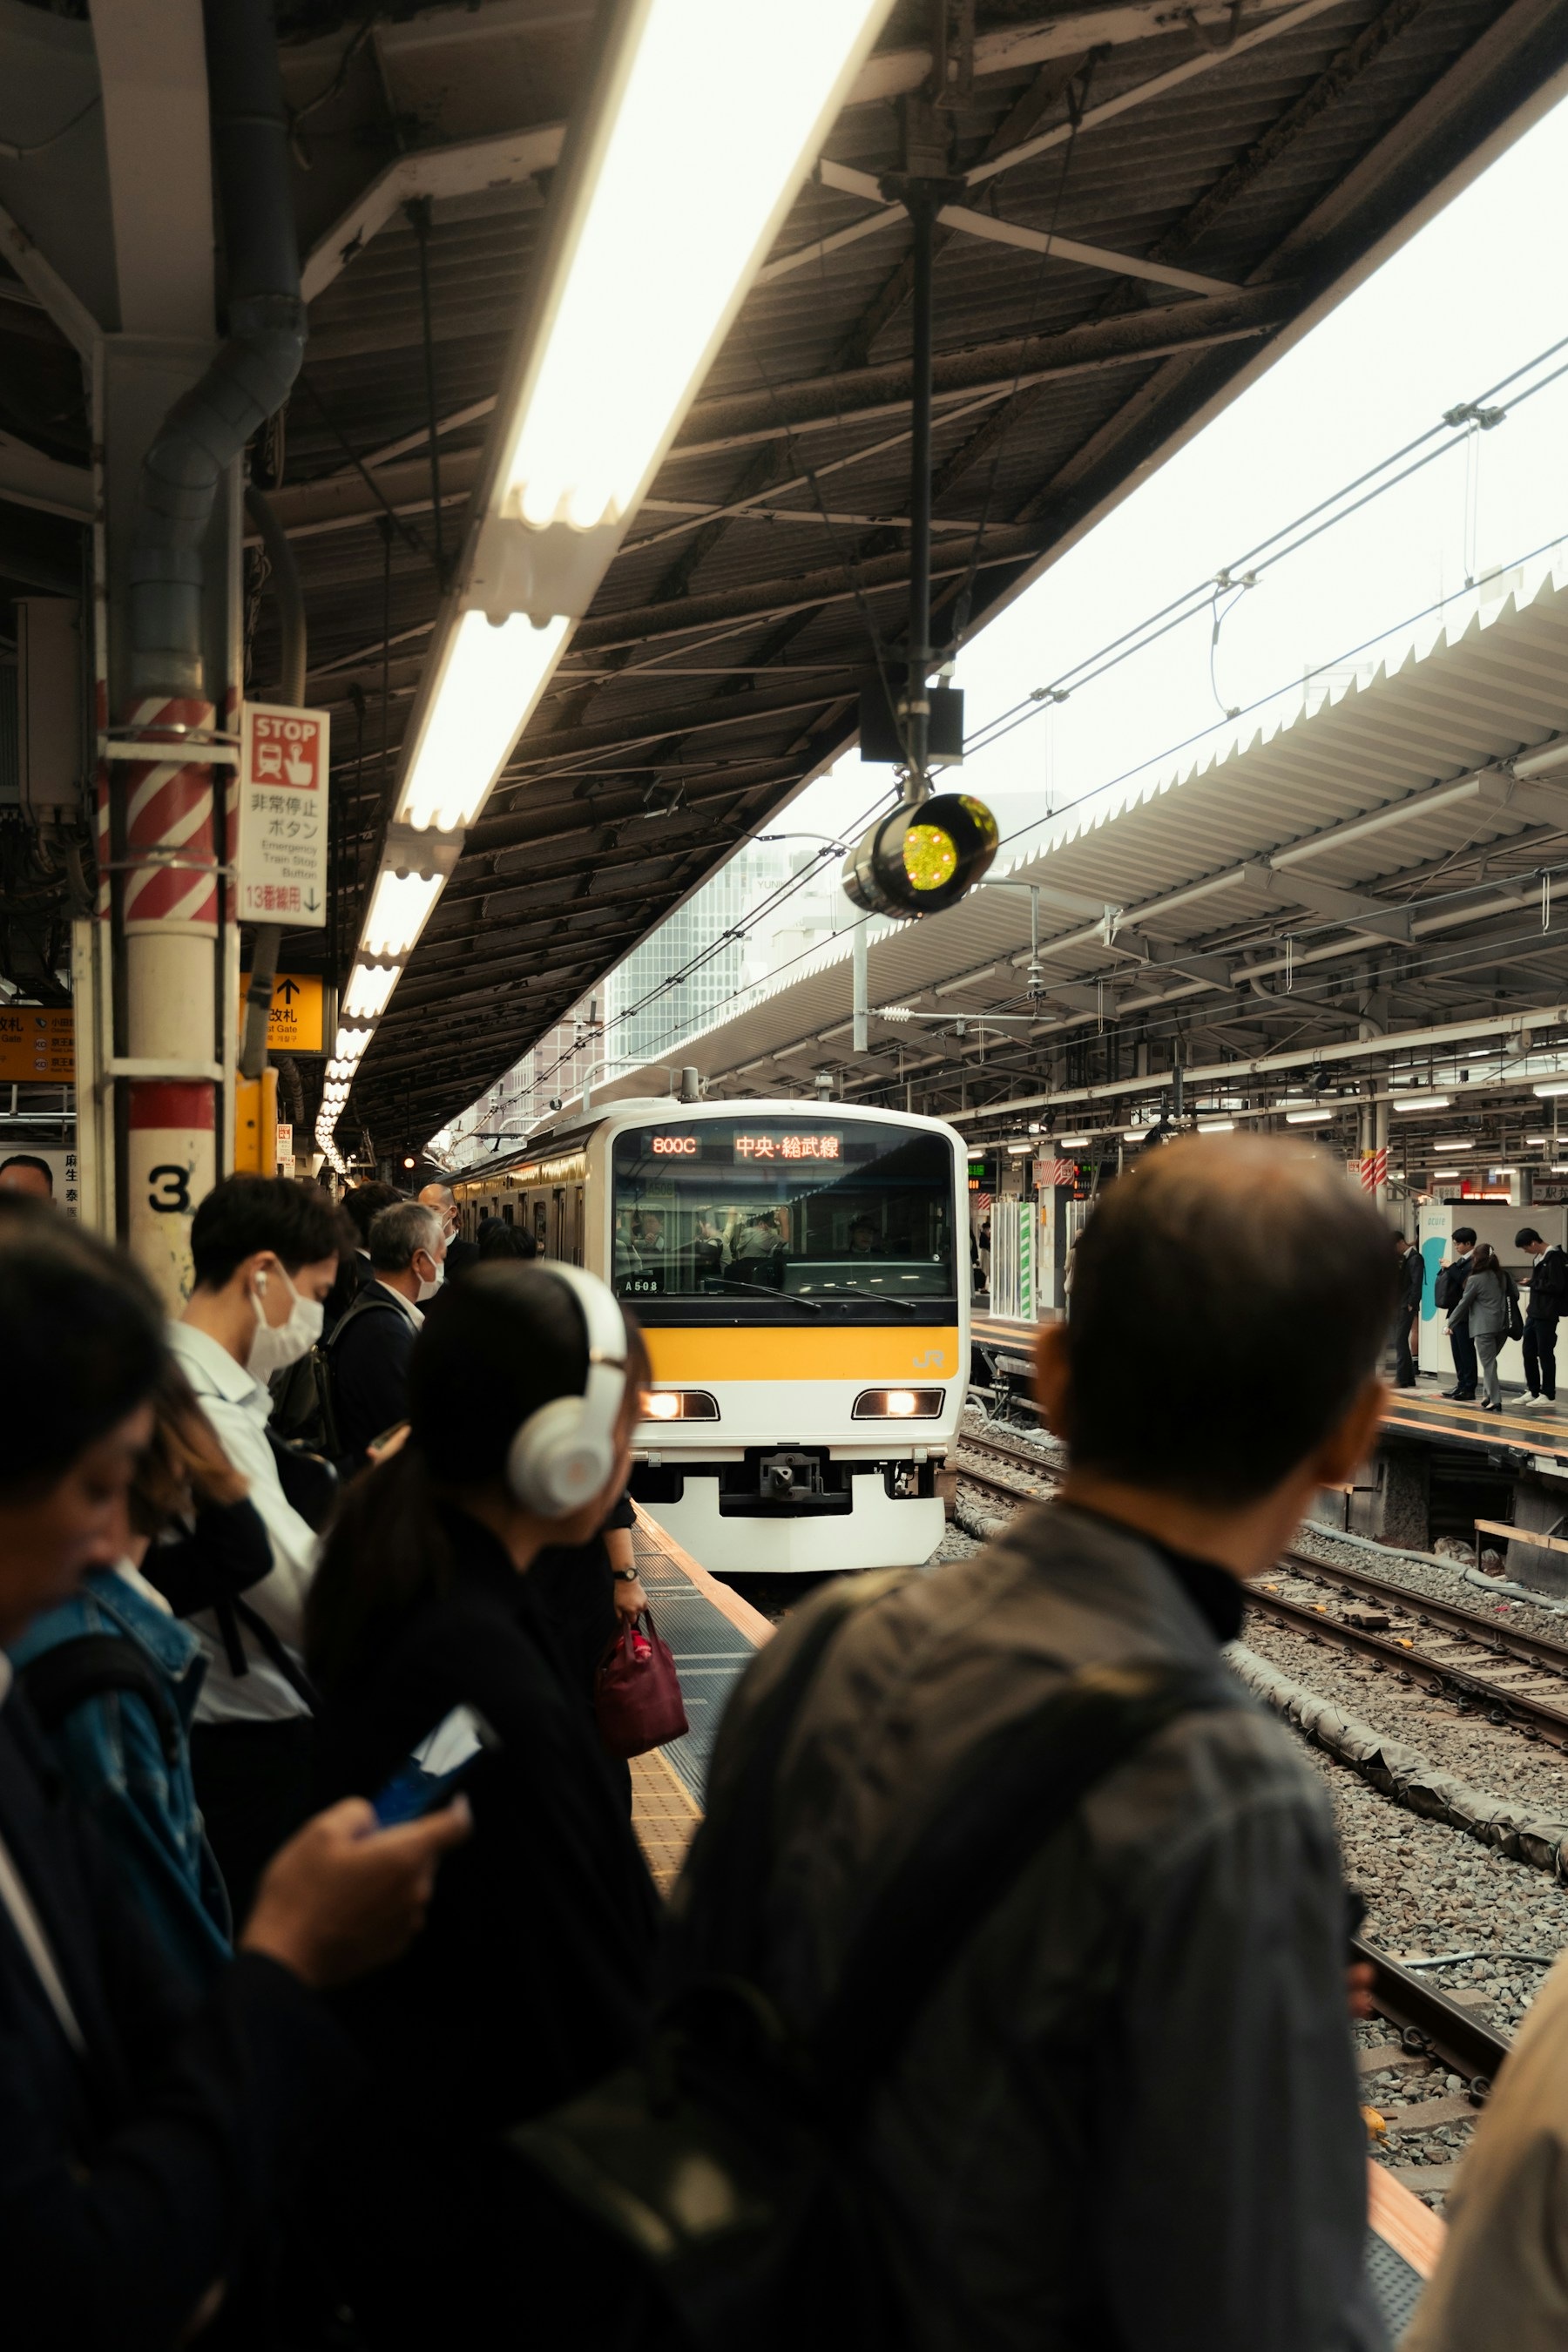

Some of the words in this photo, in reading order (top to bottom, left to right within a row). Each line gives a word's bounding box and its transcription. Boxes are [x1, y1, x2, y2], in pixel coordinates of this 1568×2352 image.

[256, 718, 316, 742] STOP
[251, 793, 318, 818] 非常停止
[269, 818, 318, 839] ボタン
[261, 840, 318, 855] Emergency
[263, 853, 289, 865] Train
[293, 856, 317, 868] Stop
[282, 868, 317, 880] Button
[247, 884, 301, 913] 13番線用
[653, 1138, 696, 1153] 800C
[148, 1165, 190, 1213] 3
[625, 1281, 657, 1291] A508
[913, 1350, 944, 1368] JR
